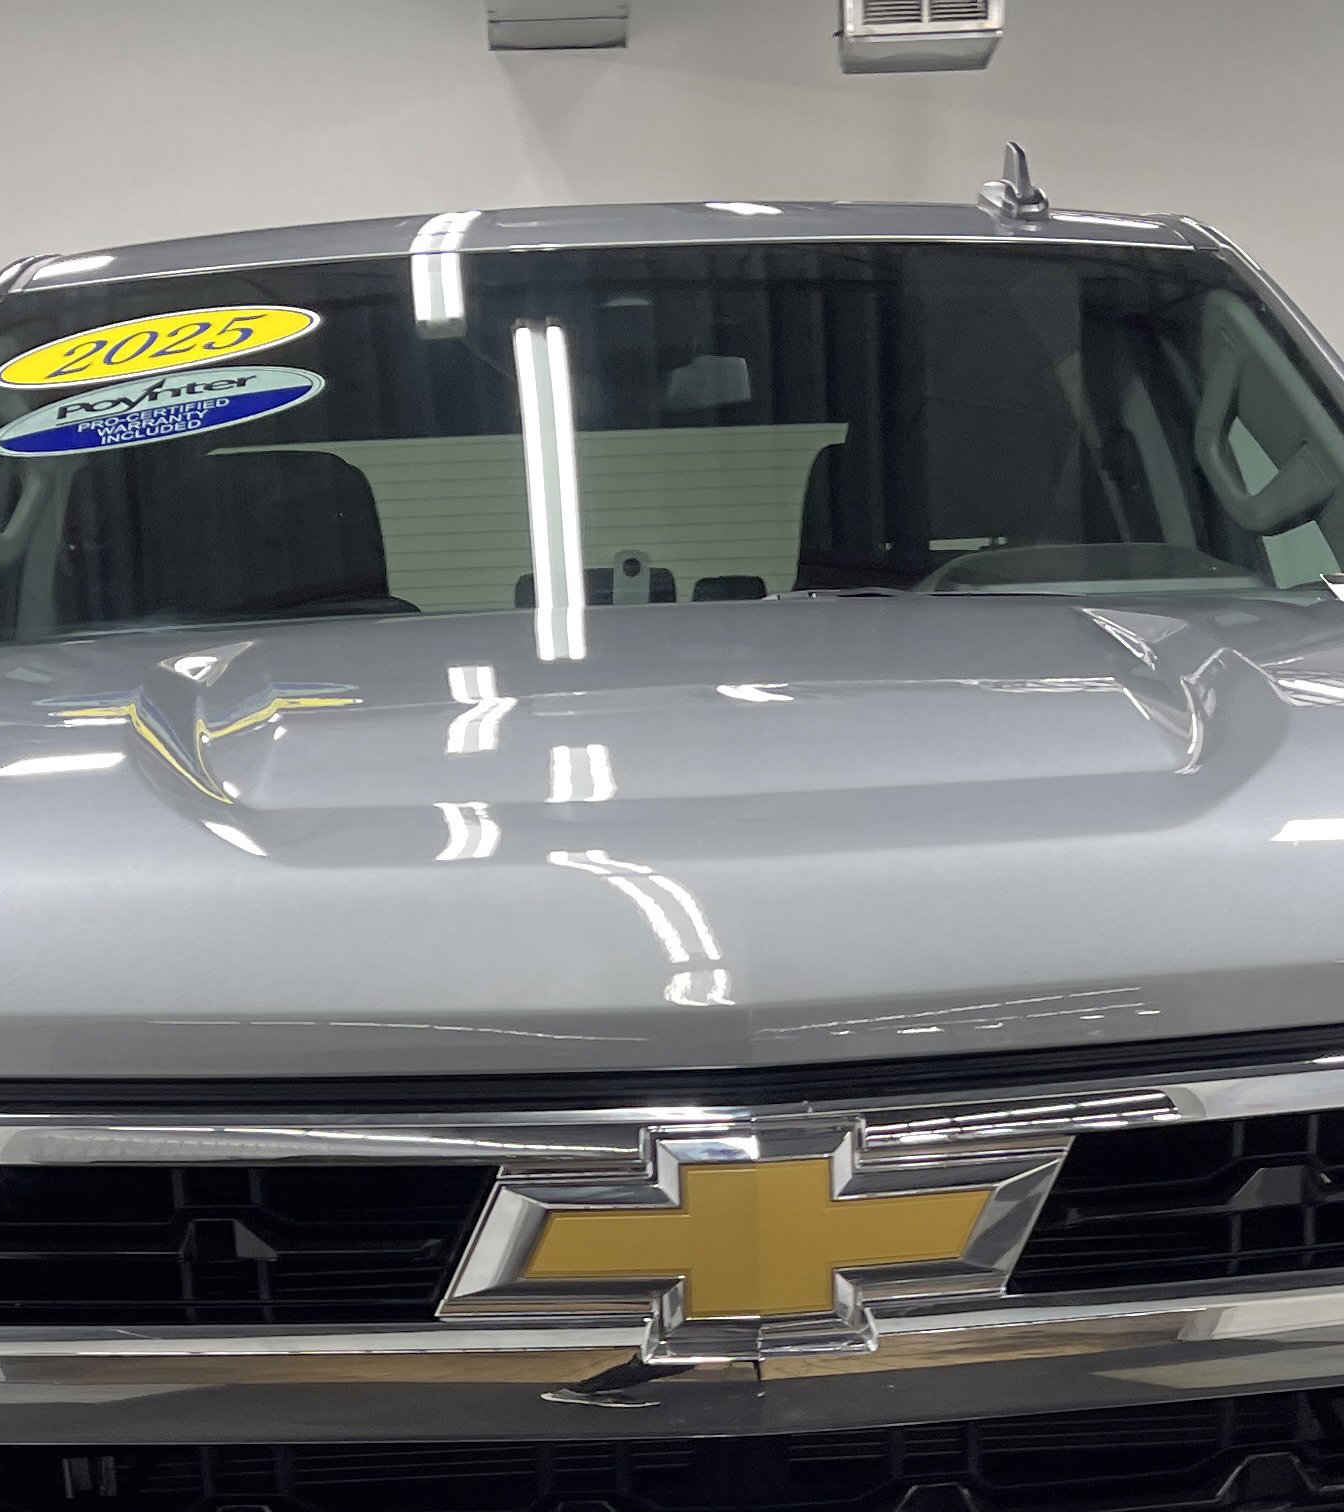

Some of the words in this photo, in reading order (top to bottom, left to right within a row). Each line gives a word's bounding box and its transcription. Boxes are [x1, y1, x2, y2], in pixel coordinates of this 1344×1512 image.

[46, 313, 267, 379] 2025
[56, 374, 257, 421] Poynter
[77, 398, 230, 432] PRO-CERTIFIED
[97, 409, 209, 437] WARRANTY
[100, 420, 202, 444] INCLUDED
